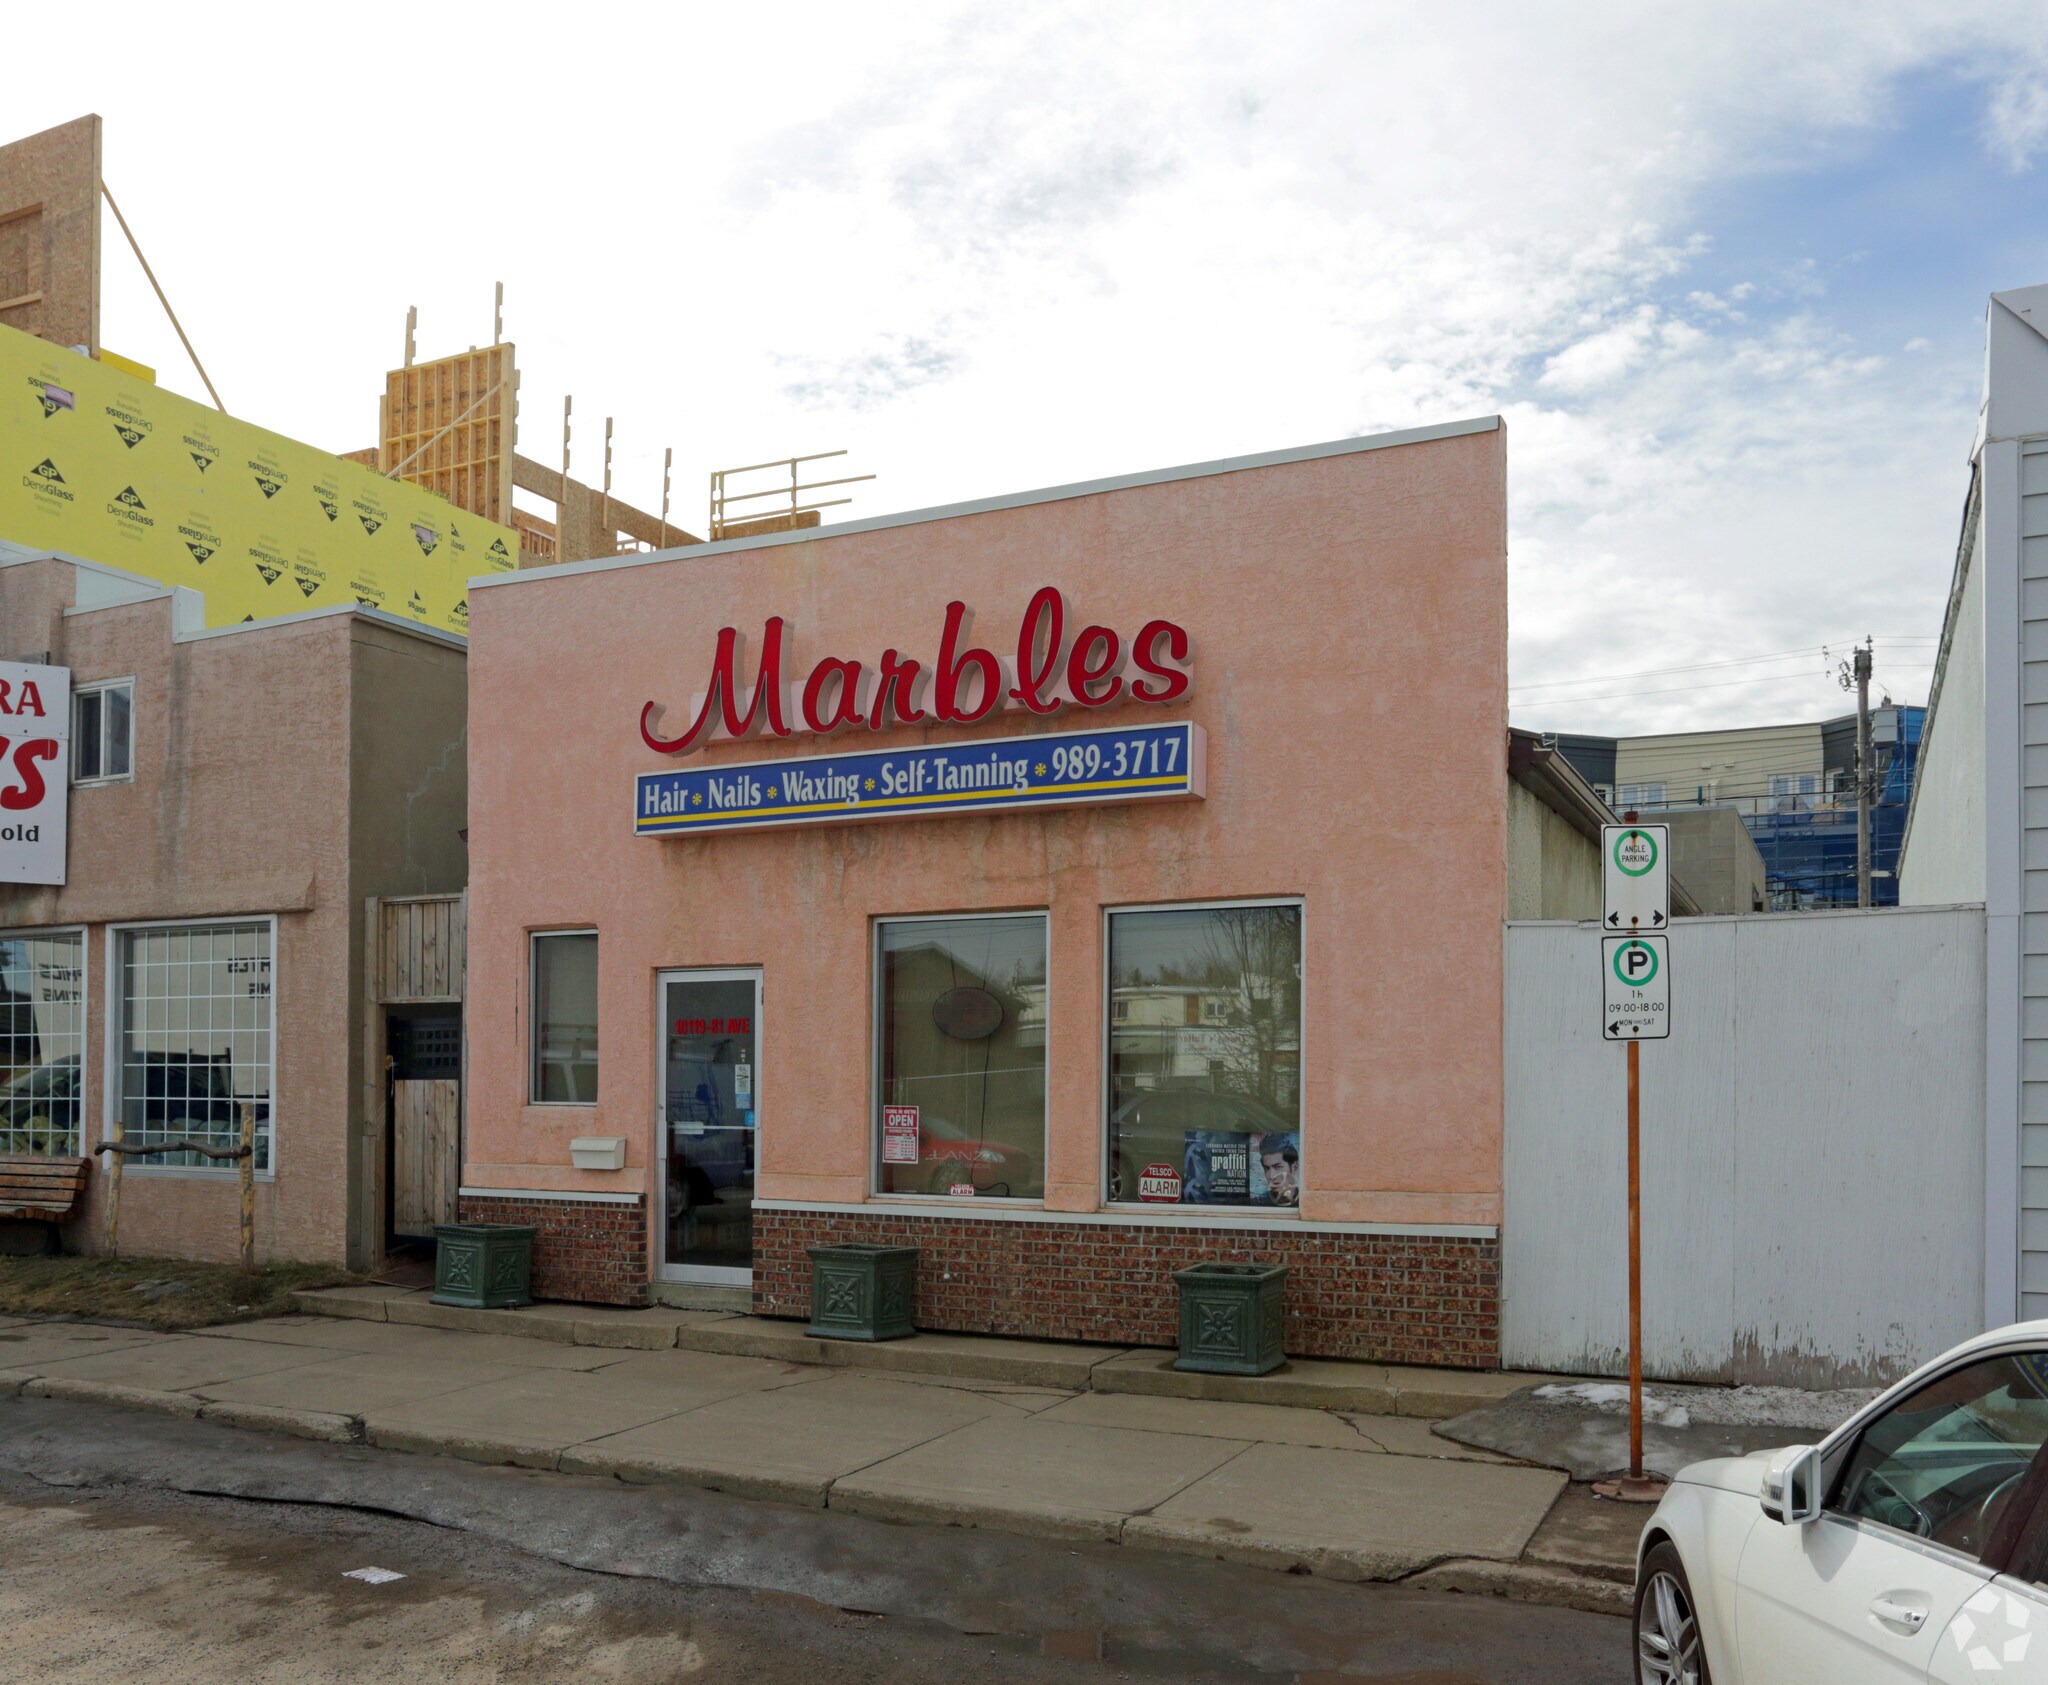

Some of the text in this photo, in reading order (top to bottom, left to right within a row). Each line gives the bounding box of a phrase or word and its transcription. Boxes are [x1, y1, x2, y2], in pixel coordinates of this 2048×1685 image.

[105, 406, 153, 432] DensGlass
[121, 430, 139, 443] GP
[38, 464, 58, 478] GP
[248, 461, 288, 483] DensGlass
[22, 475, 74, 502] DensGlass
[261, 482, 277, 494] GP
[121, 492, 139, 505] GP
[107, 503, 154, 527] DensGlass
[364, 519, 378, 530] GP
[178, 525, 221, 547] DensGlass
[192, 546, 209, 558] GP
[493, 543, 505, 552] GP
[249, 548, 289, 569] DensGlass
[485, 552, 515, 570] DensGlass
[262, 568, 277, 580] GP
[301, 581, 315, 592] GP
[350, 581, 386, 601] DensGlass
[640, 586, 1193, 755] Marbles
[0, 735, 59, 811] S
[644, 736, 1182, 815] Hair Nails Waxing Self-Tanning 989-3717
[1624, 845, 1646, 854] ANGLE
[1621, 854, 1650, 863] PARKING
[1627, 951, 1648, 975] P
[726, 1017, 750, 1034] AVE
[1619, 1019, 1633, 1027] MON
[1643, 1018, 1655, 1026] SAT
[888, 1114, 914, 1127] OPEN
[1211, 1154, 1246, 1172] graffiti
[1149, 1167, 1173, 1177] TELSCO
[1226, 1169, 1247, 1178] NATION
[1141, 1179, 1179, 1195] ALARM
